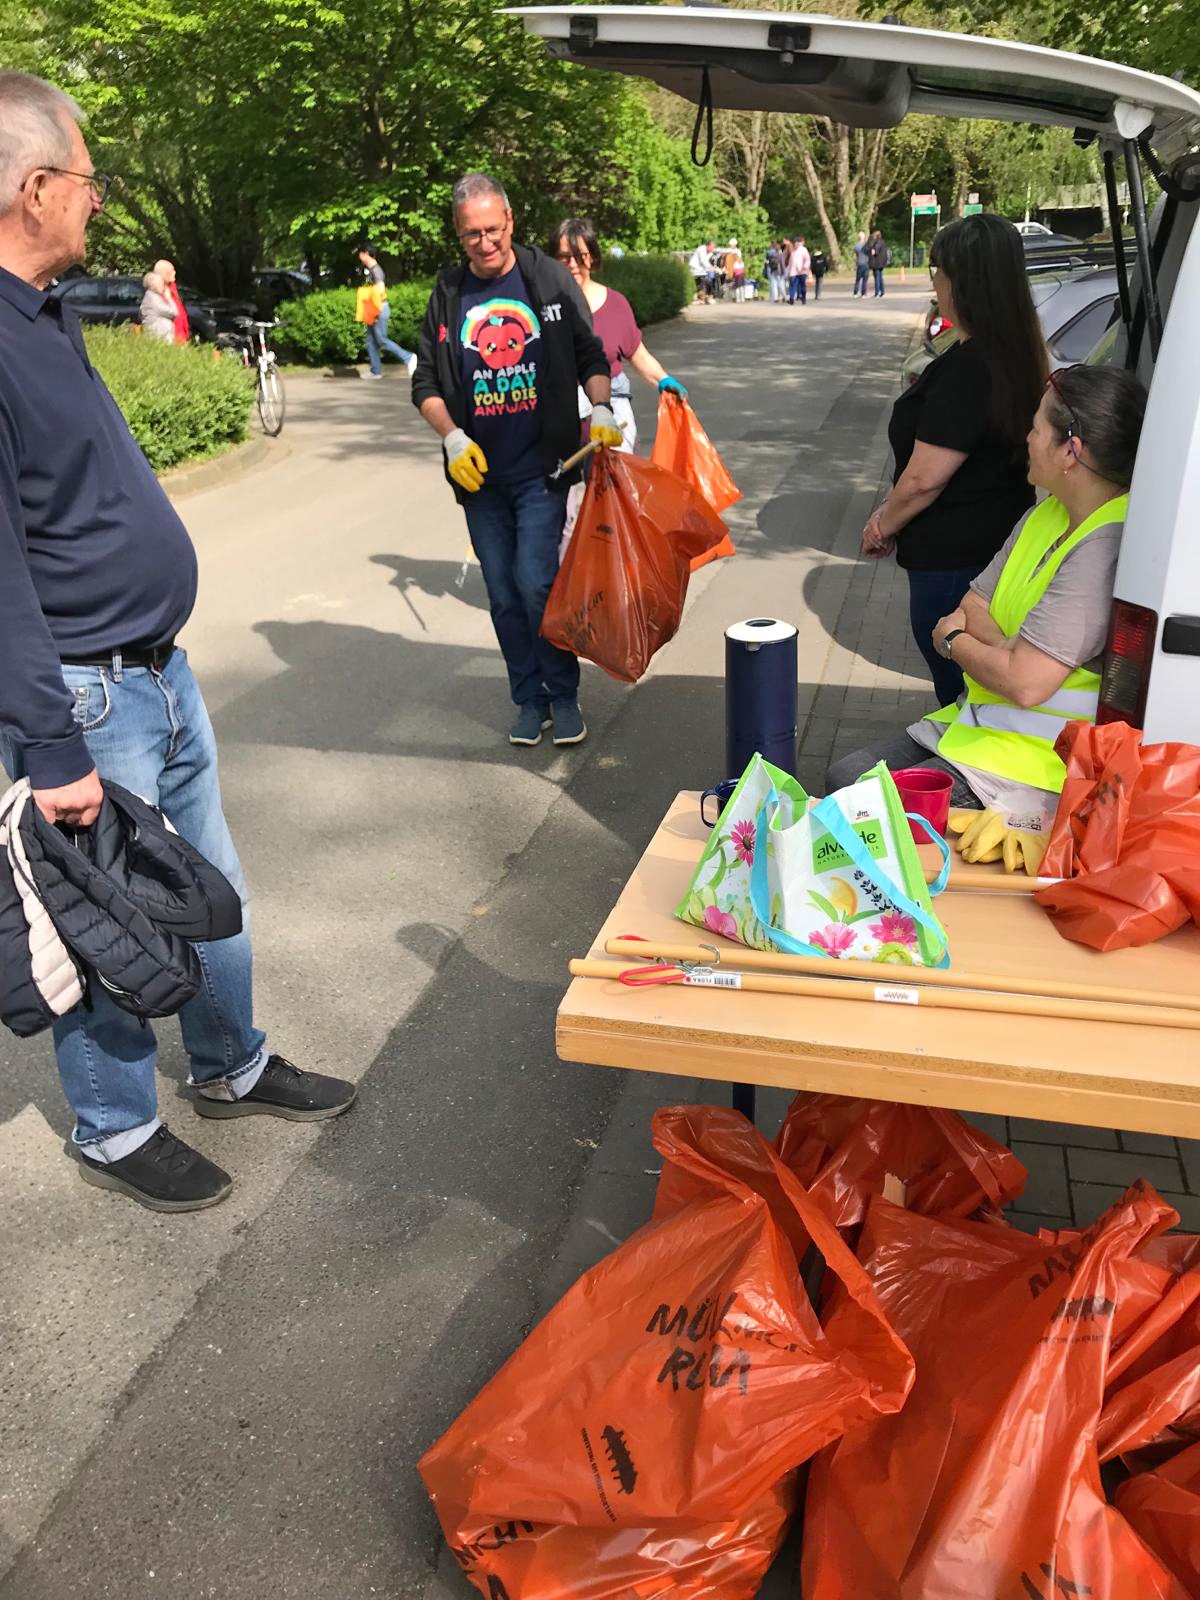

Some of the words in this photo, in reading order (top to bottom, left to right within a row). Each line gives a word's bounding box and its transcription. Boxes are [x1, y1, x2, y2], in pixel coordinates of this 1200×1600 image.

[473, 369, 493, 381] AN
[496, 362, 536, 378] APPLE
[474, 379, 489, 394] A
[496, 372, 536, 393] DAY
[473, 391, 506, 406] YOU
[511, 386, 537, 403] DIE
[474, 399, 538, 417] ANYWAY
